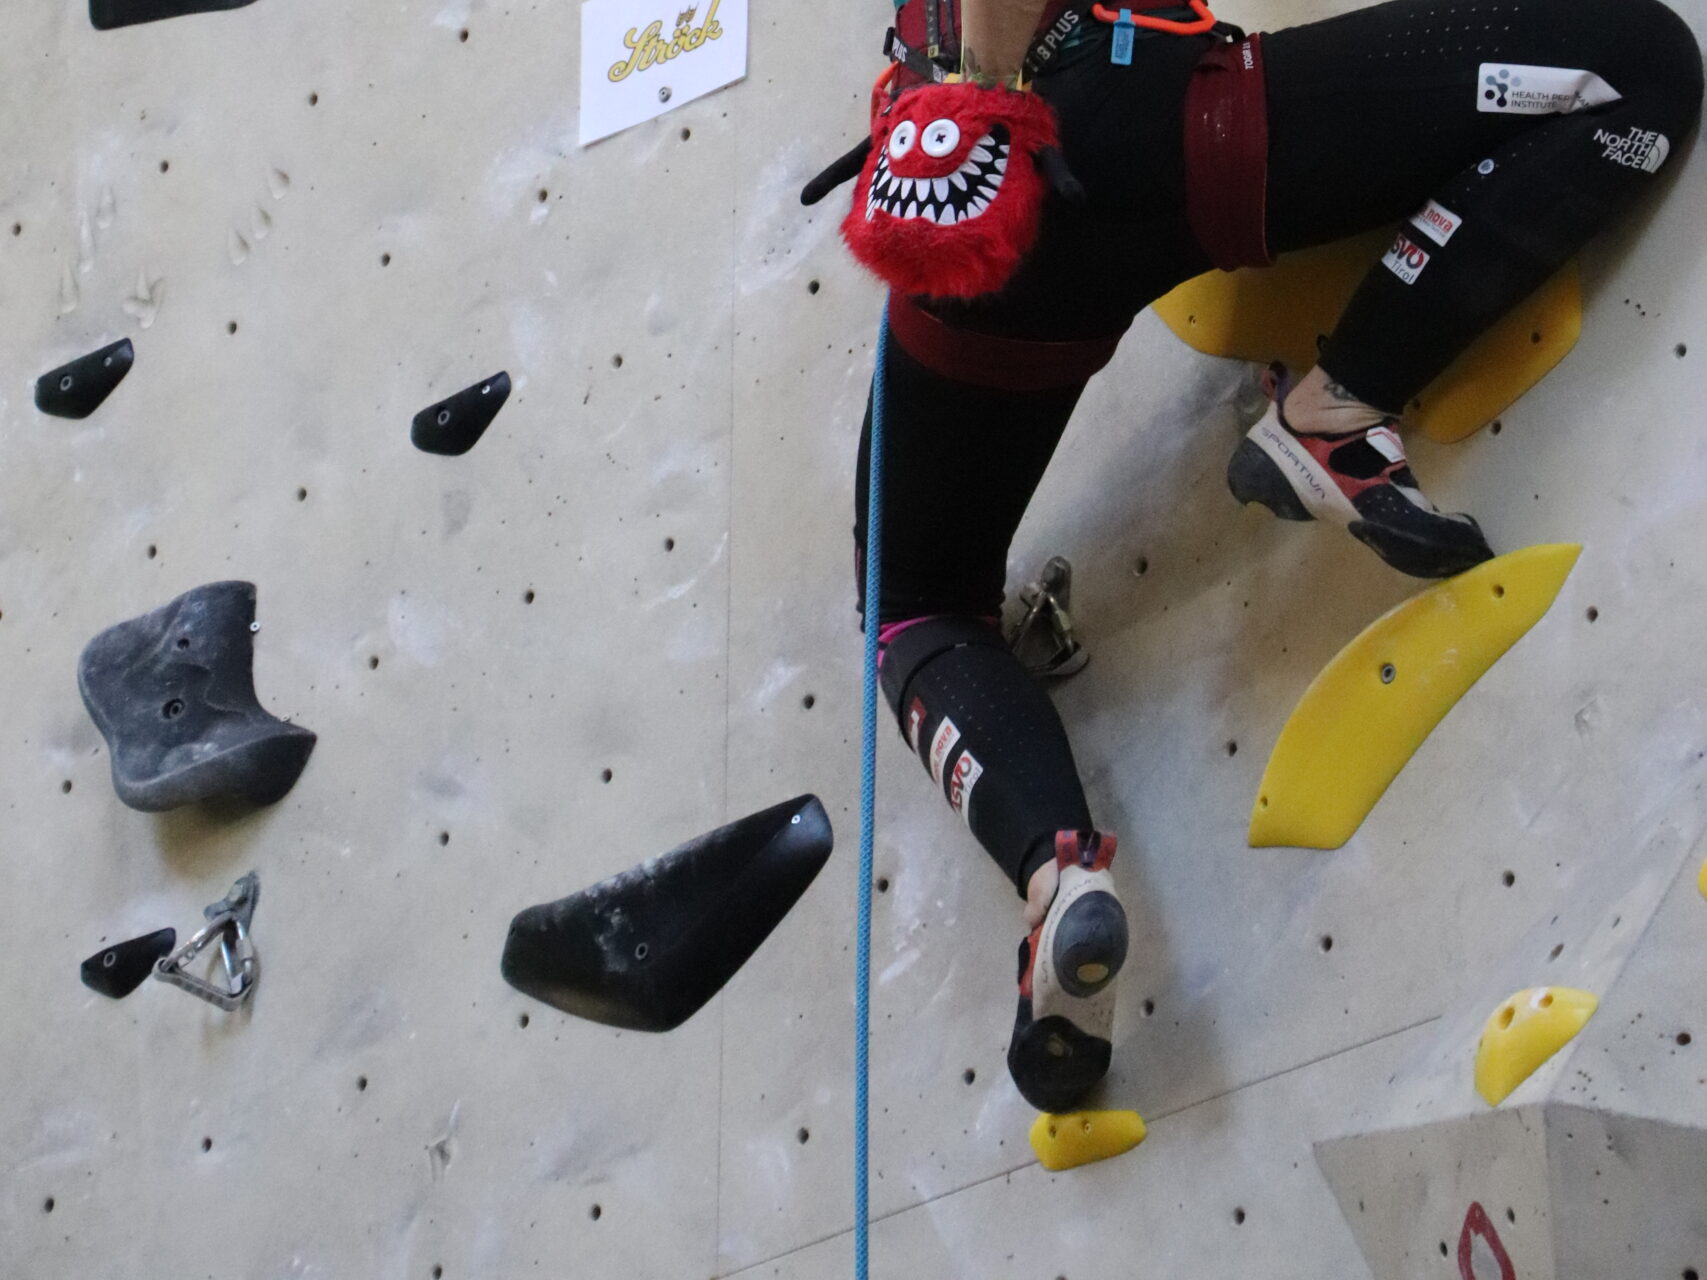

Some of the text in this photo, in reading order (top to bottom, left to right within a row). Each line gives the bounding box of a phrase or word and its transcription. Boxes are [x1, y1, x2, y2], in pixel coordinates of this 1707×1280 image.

[1511, 90, 1549, 101] HEALTH
[1593, 128, 1654, 157] NORTH
[1627, 126, 1658, 145] THE
[1601, 146, 1645, 170] FACE
[1391, 260, 1415, 283] Tirol
[1261, 426, 1326, 500] SPORTIVA
